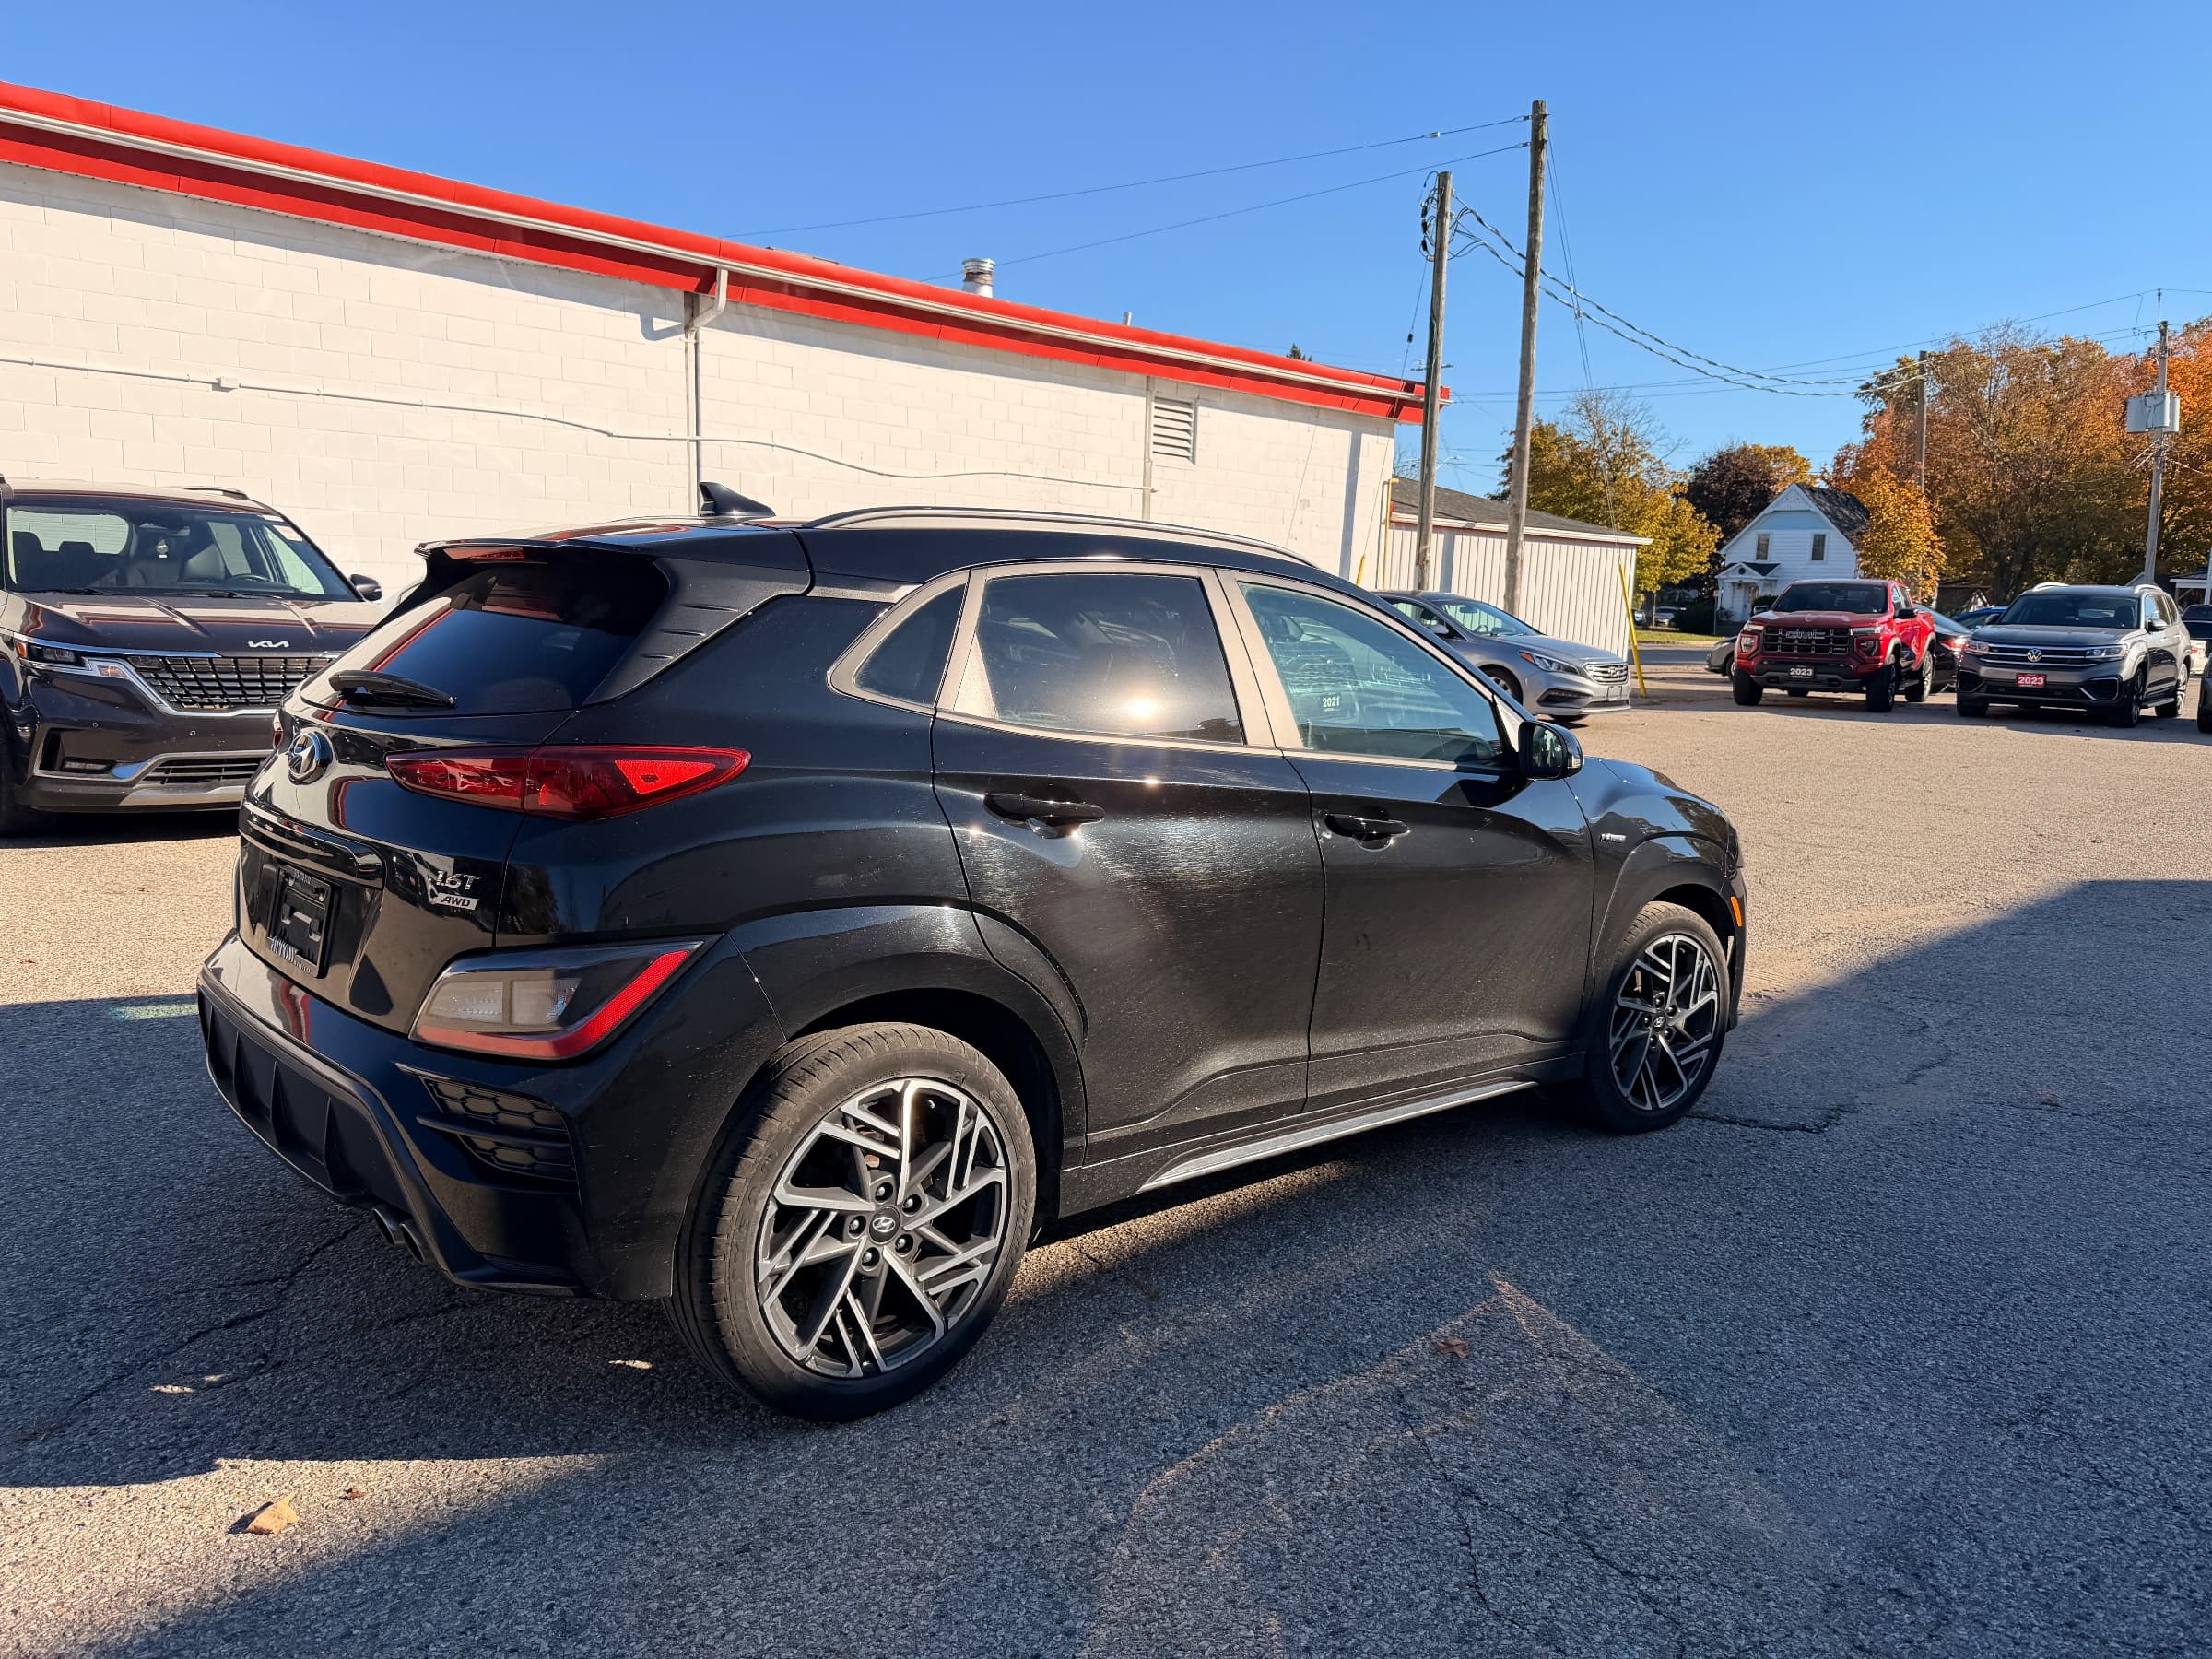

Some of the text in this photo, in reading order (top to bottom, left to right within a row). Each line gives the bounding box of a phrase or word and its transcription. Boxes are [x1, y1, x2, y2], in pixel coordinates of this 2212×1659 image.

[2018, 676, 2044, 685] 2023
[1322, 695, 1340, 708] 2021
[441, 896, 471, 907] AWD
